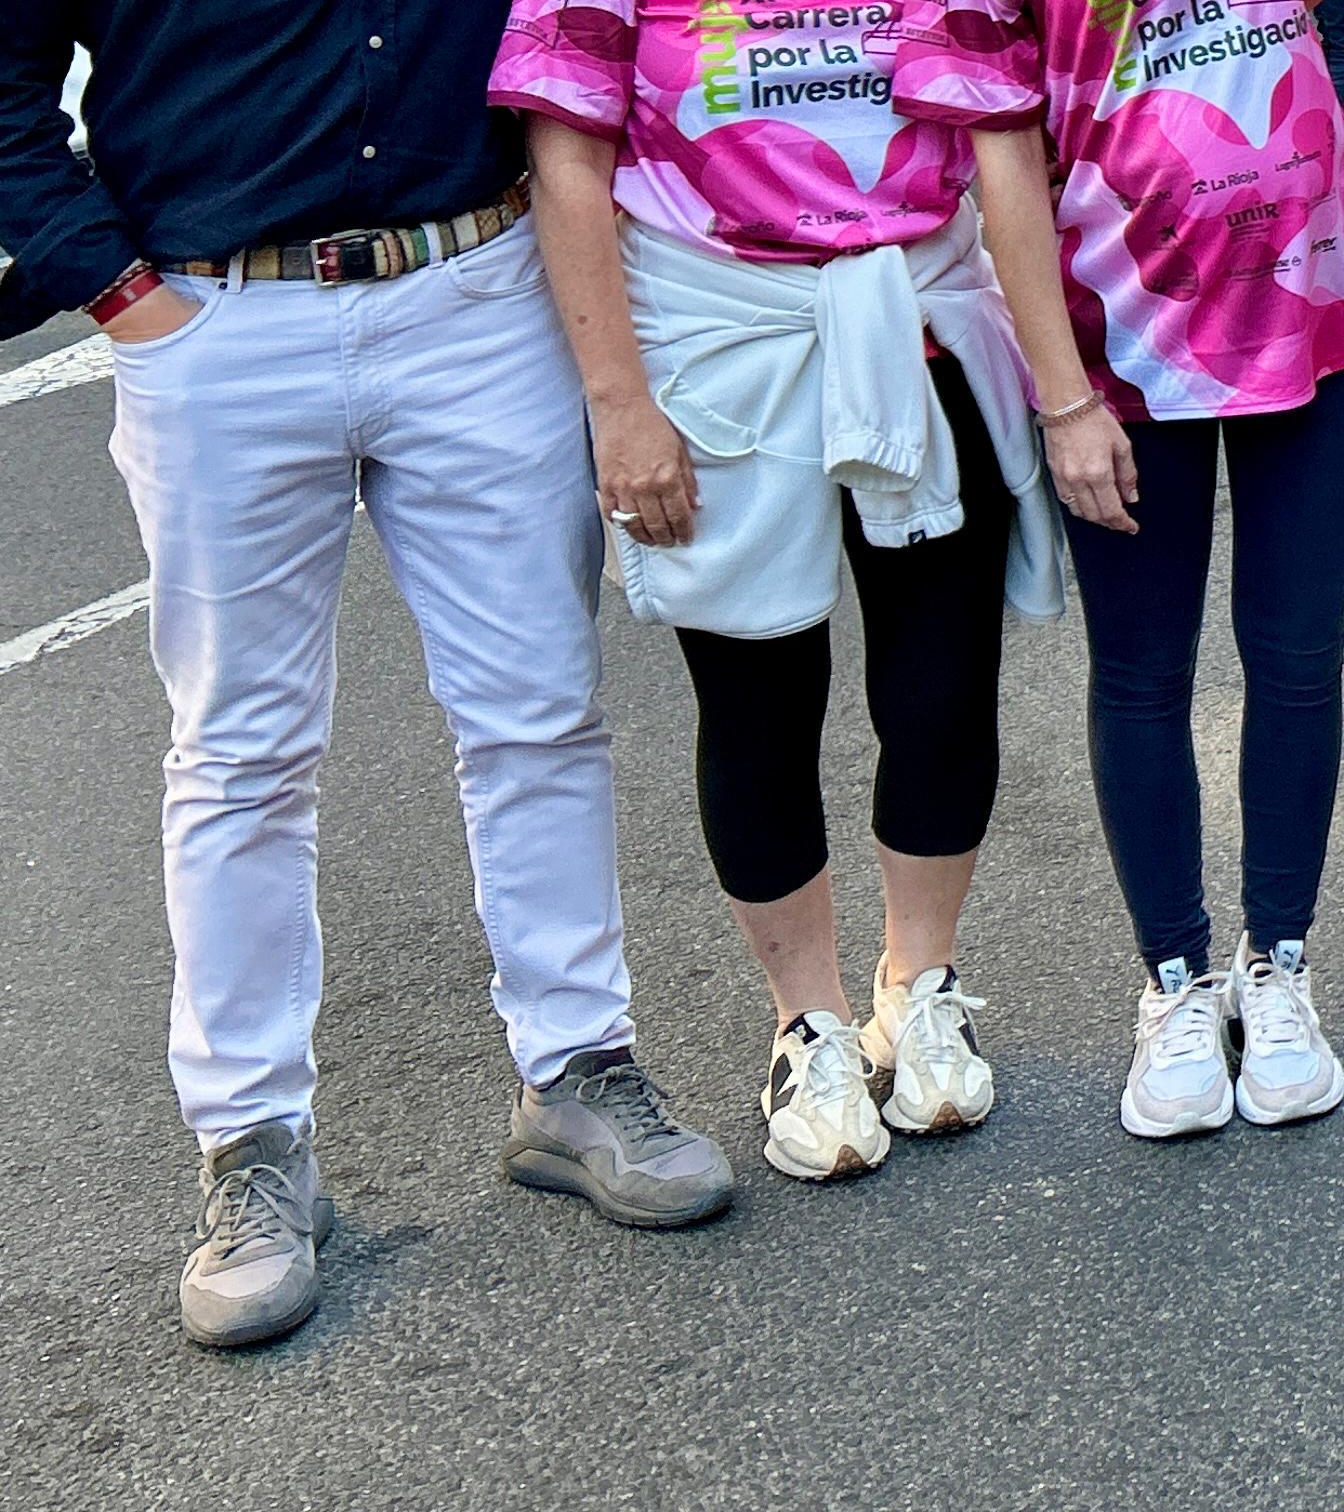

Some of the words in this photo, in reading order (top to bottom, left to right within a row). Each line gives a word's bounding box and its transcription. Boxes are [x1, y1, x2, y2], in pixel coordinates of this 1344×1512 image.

[1137, 10, 1186, 51] por
[747, 45, 808, 77] por
[818, 38, 859, 64] la
[751, 72, 893, 108] Investig
[1210, 177, 1227, 192] La
[1227, 170, 1260, 187] Rioja
[816, 214, 832, 226] La
